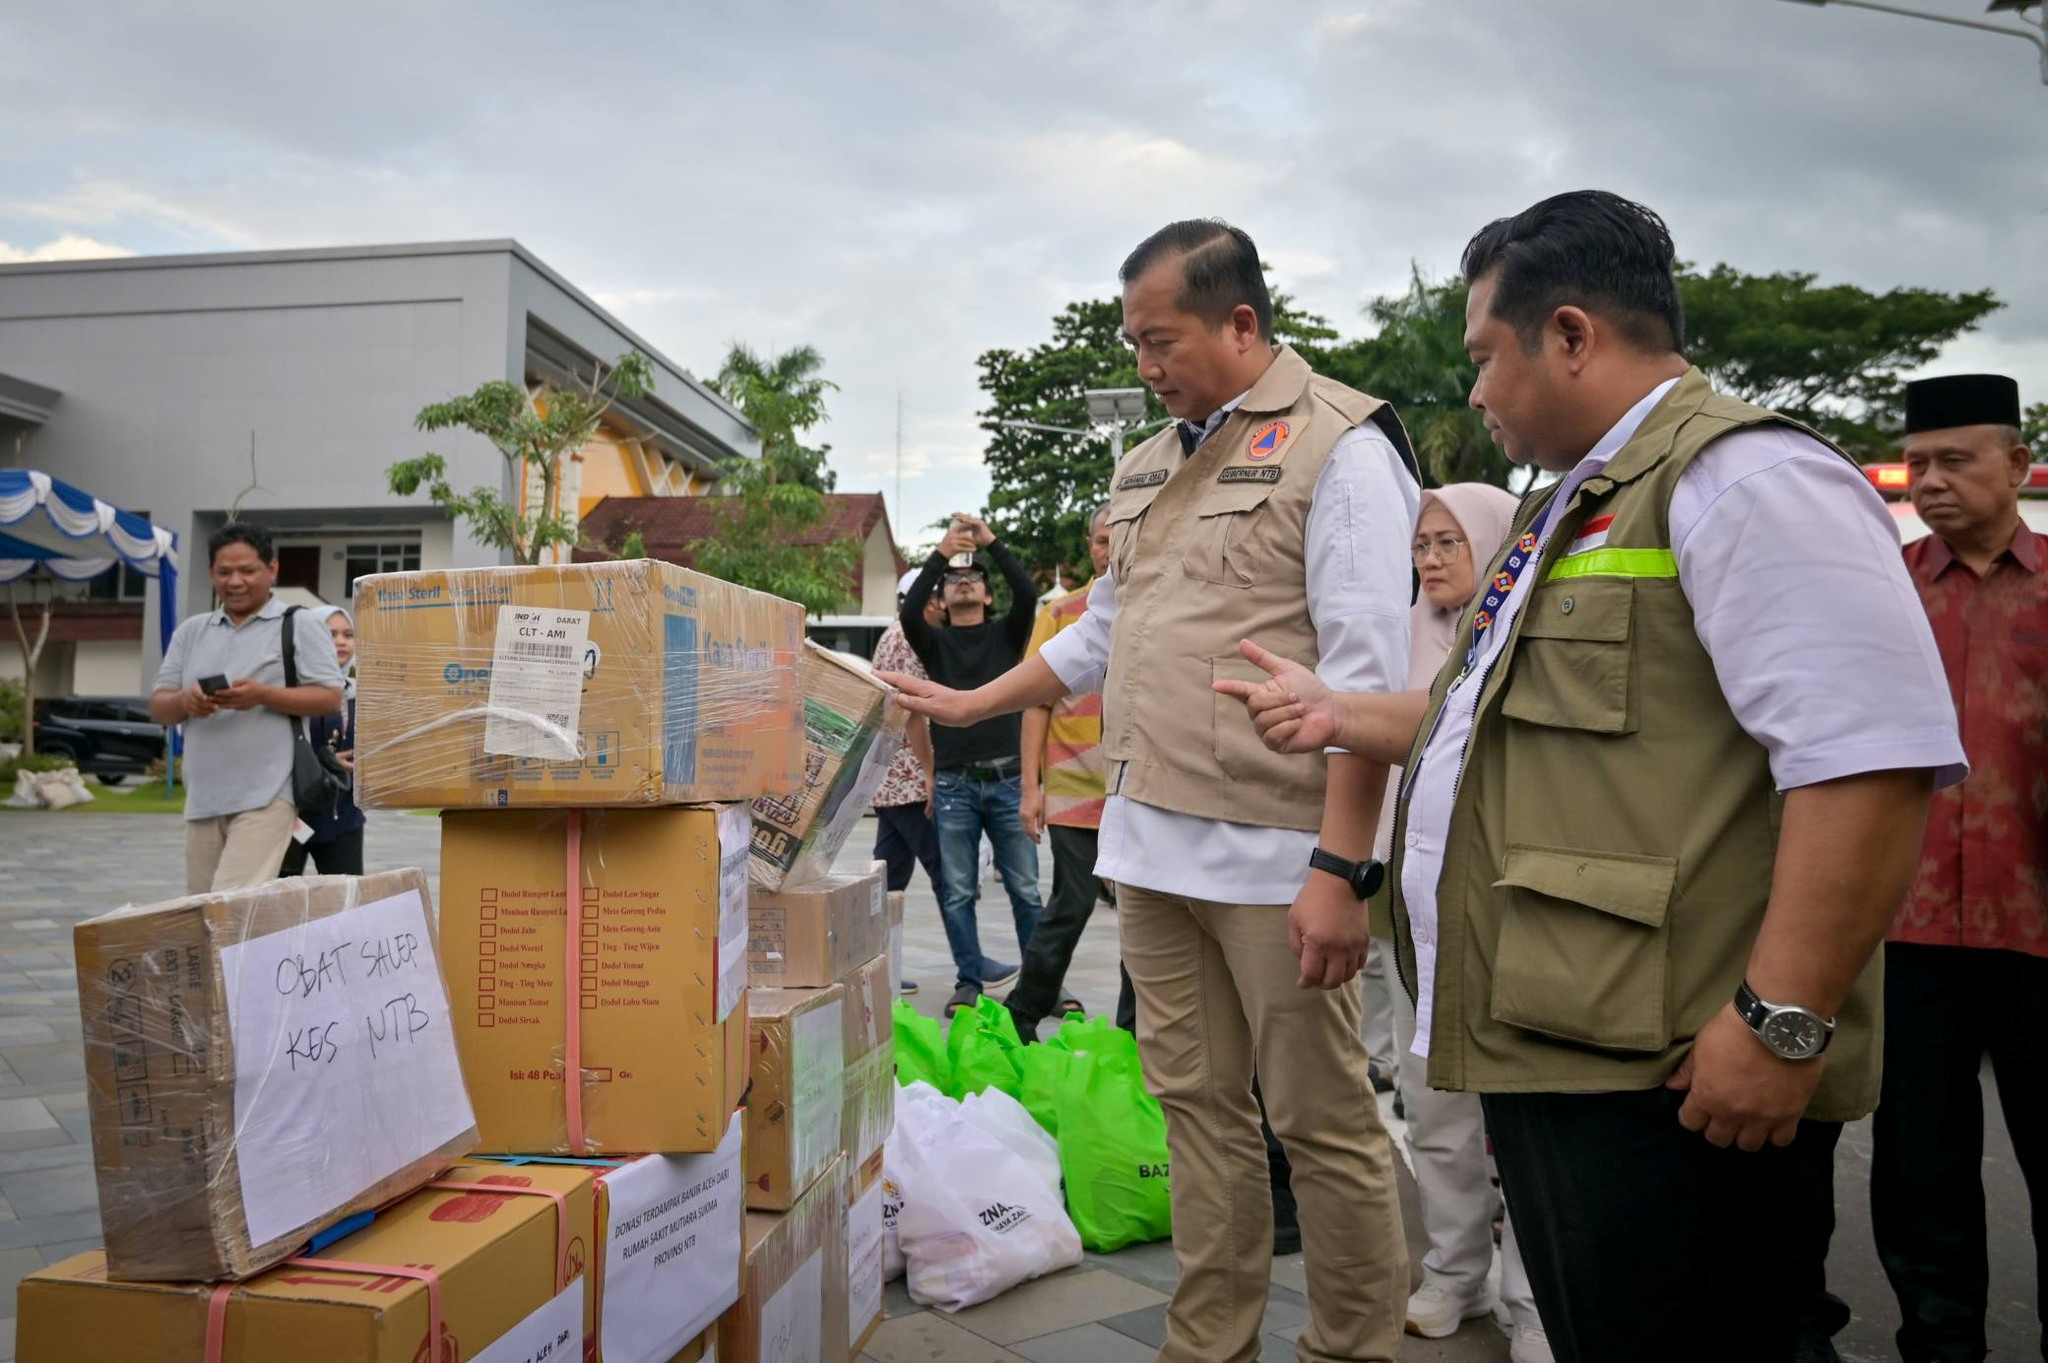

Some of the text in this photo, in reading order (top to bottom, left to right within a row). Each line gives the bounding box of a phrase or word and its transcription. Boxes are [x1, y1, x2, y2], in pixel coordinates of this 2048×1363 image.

[519, 627, 537, 638] CLT
[546, 628, 566, 639] AMI
[276, 933, 418, 998] OBAT SALEP
[286, 992, 430, 1072] KES NTB
[615, 1214, 642, 1239] DONASI
[642, 1195, 681, 1223] TERDAMPAK
[978, 1202, 1013, 1226] ZNA
[623, 1237, 649, 1261] RUMAH
[650, 1225, 669, 1246] SAKIT
[653, 1240, 683, 1268] PROVINSI
